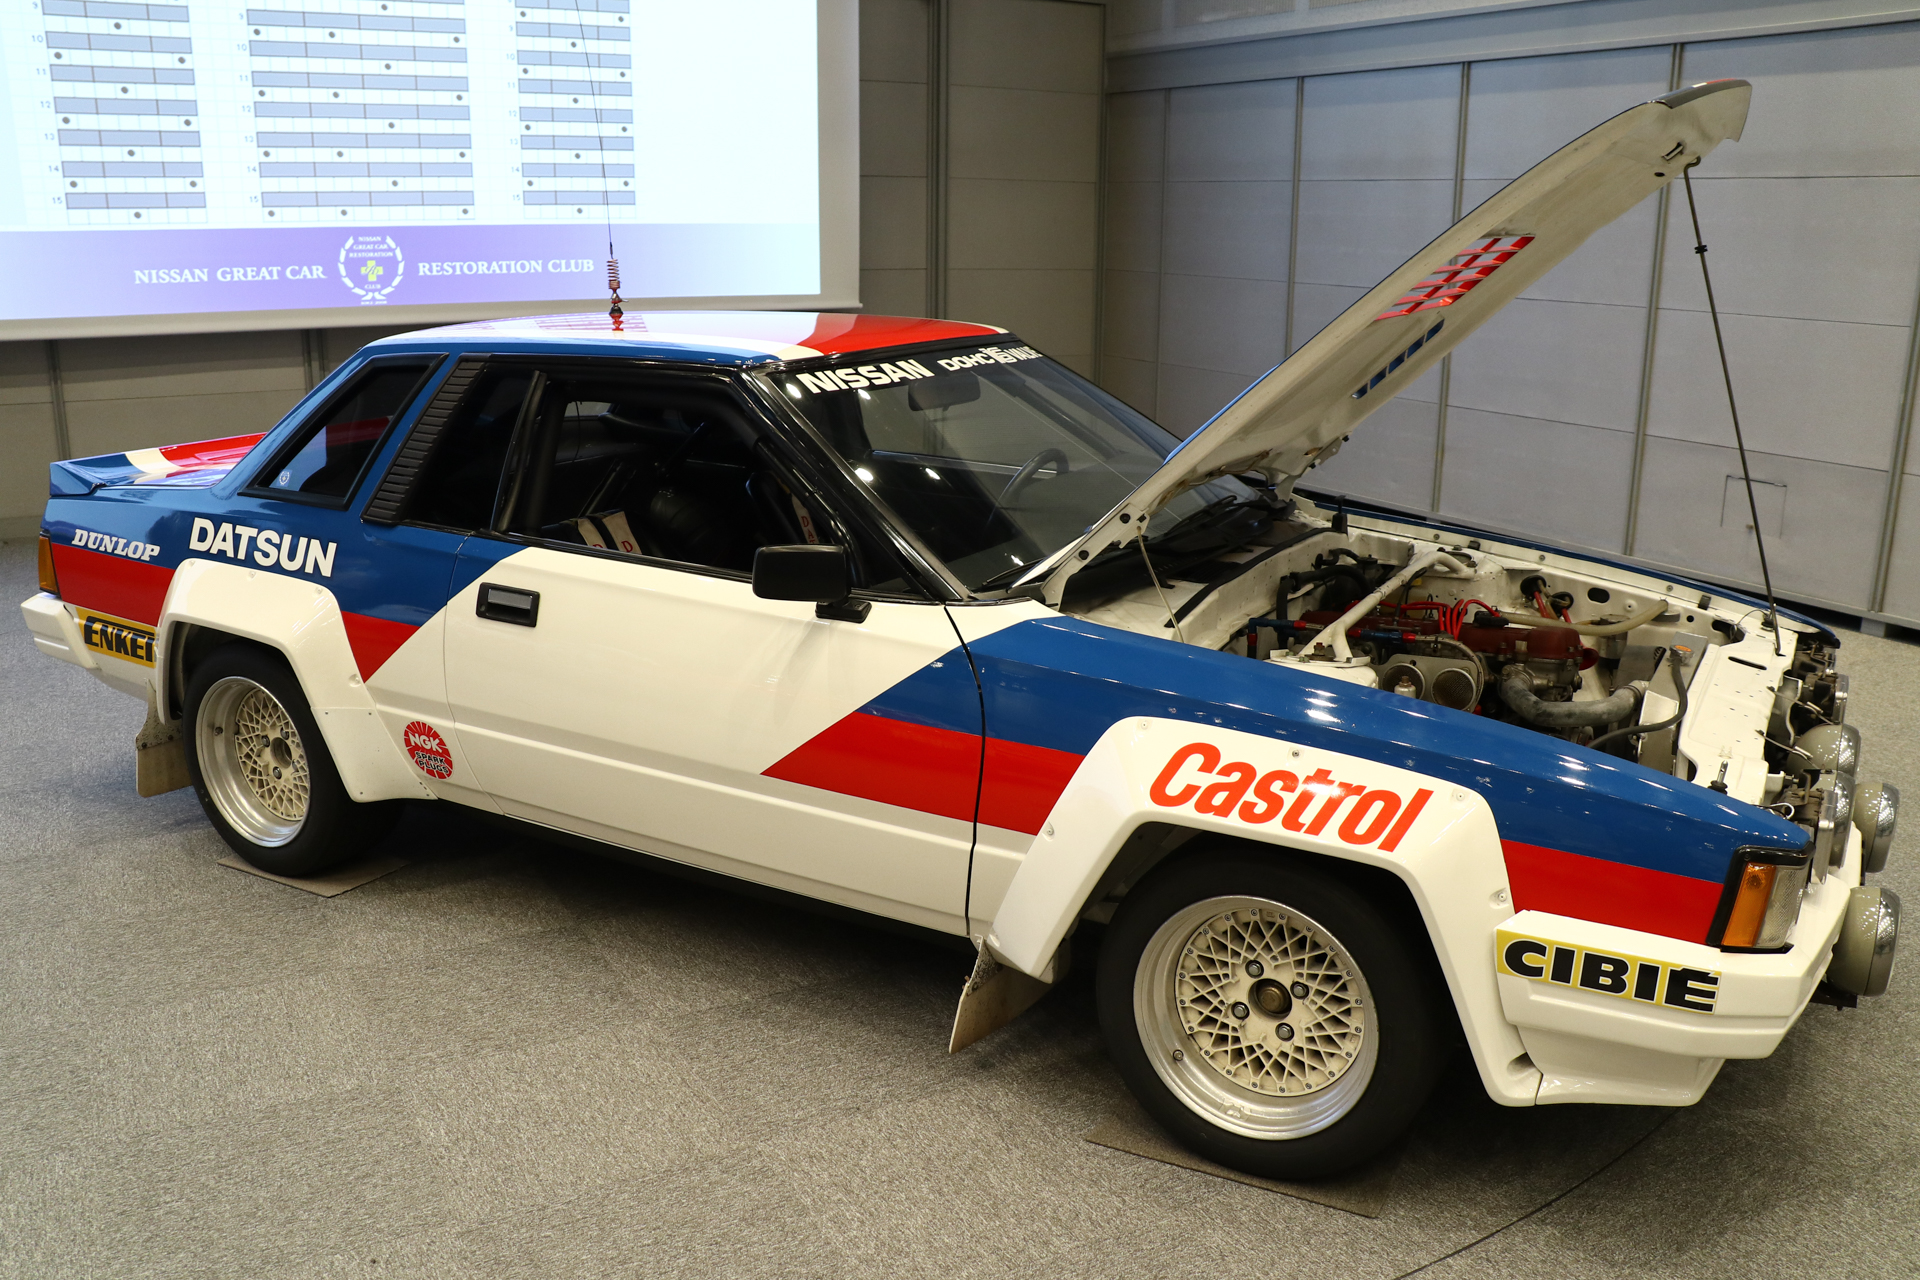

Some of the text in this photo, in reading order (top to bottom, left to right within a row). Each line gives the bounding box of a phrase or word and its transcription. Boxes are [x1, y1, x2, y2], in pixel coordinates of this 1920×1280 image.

[31, 34, 44, 43] 10
[236, 43, 248, 52] 10
[36, 67, 46, 76] 11
[40, 100, 51, 109] 12
[134, 265, 328, 284] NISSAN GREAT CAR
[418, 259, 595, 276] RESTORATION CLUB
[936, 353, 995, 371] DOHC
[796, 359, 935, 394] NISSAN
[71, 529, 160, 561] DUNLOP
[189, 517, 337, 577] DATSUN
[84, 615, 155, 663] ENKEI
[408, 732, 442, 753] NGK
[415, 751, 445, 765] SPARK
[418, 760, 449, 774] PLUGS
[1149, 742, 1434, 852] Castrol
